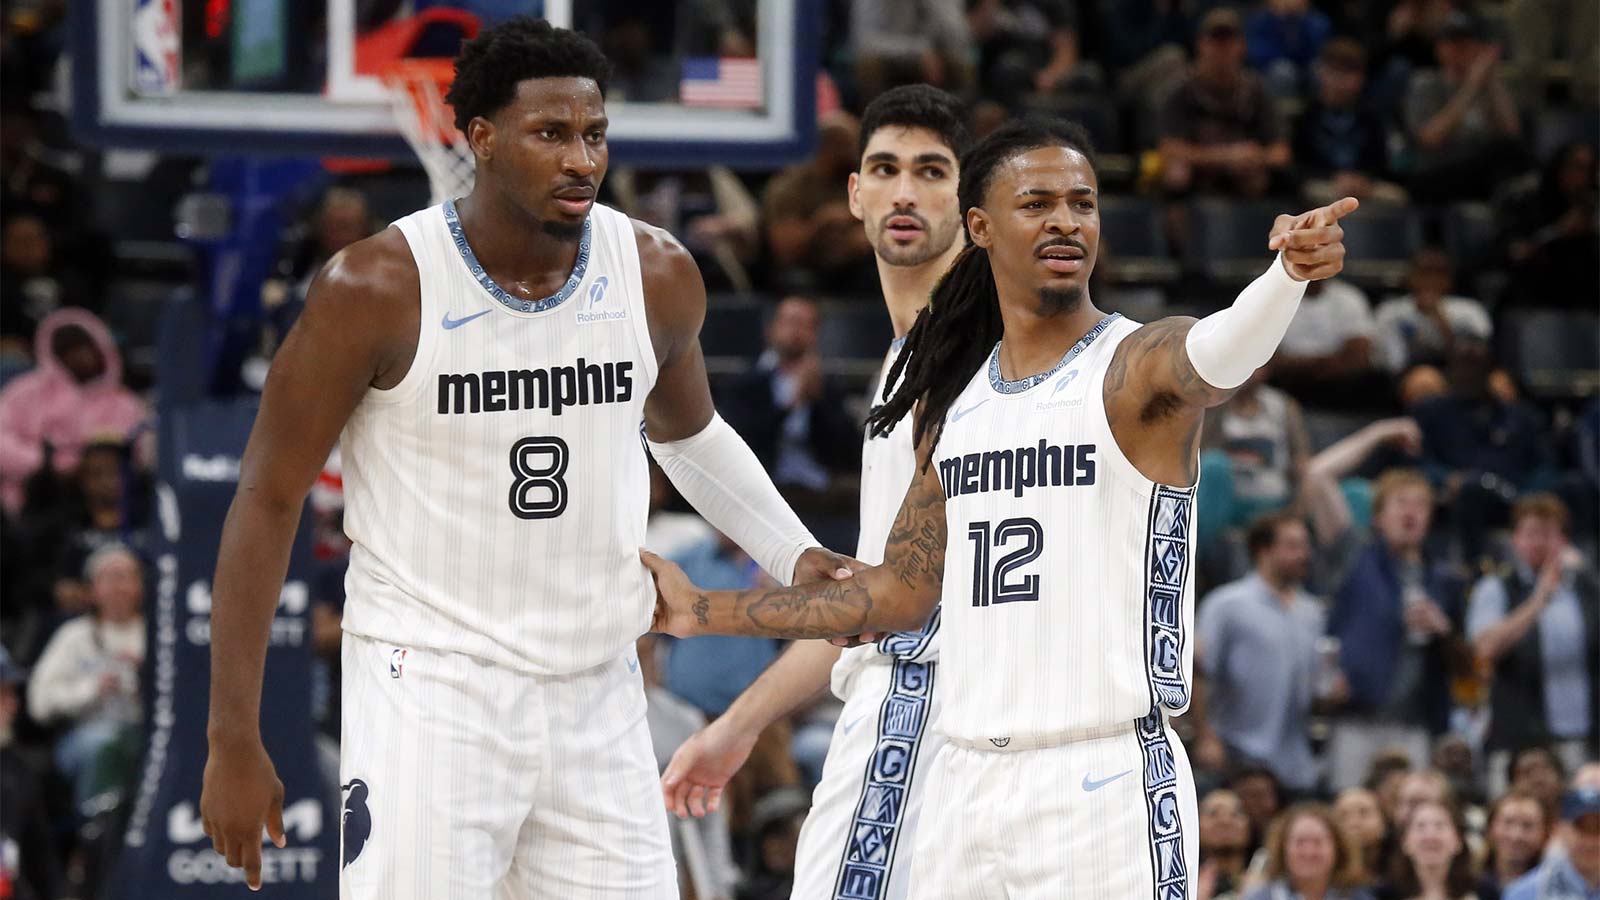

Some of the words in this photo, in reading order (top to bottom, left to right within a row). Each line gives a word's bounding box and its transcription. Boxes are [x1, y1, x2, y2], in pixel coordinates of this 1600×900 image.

[577, 309, 626, 322] Robinhood
[438, 358, 633, 416] memphis
[1035, 398, 1083, 411] Robinhood
[509, 436, 569, 519] 8
[939, 438, 1096, 500] memphis
[968, 517, 1044, 607] 12
[168, 848, 322, 885] GOSETT
